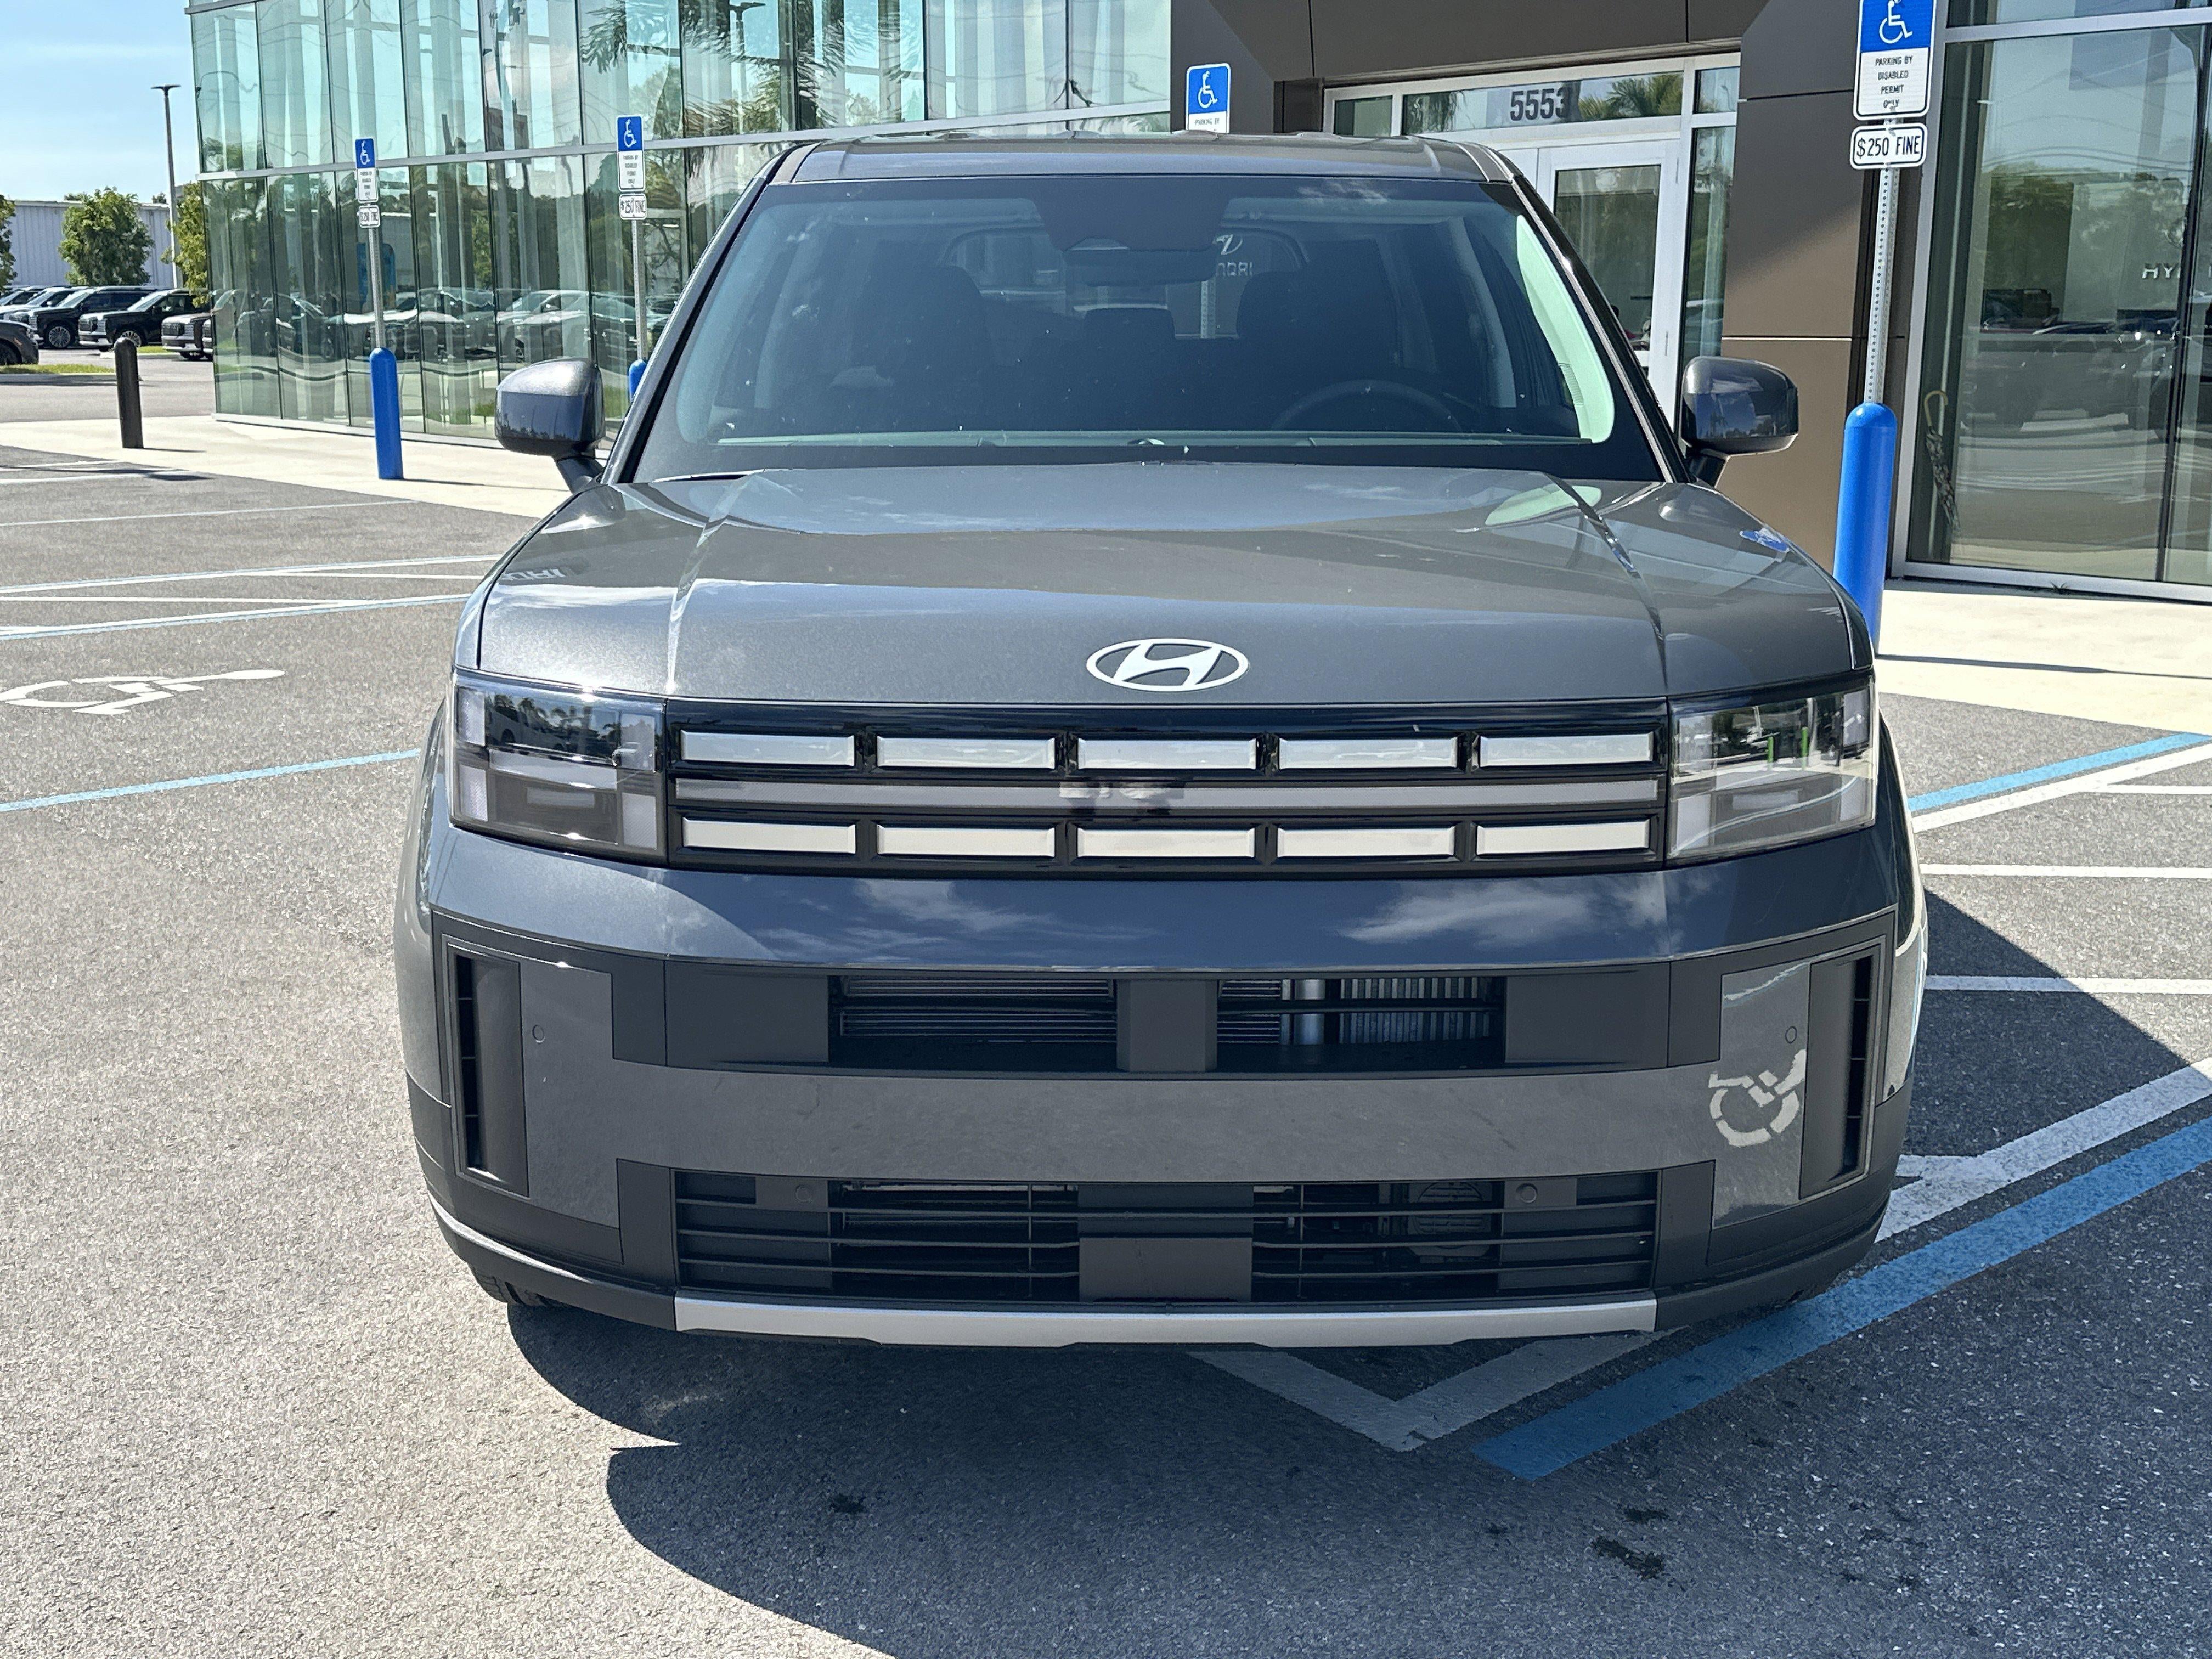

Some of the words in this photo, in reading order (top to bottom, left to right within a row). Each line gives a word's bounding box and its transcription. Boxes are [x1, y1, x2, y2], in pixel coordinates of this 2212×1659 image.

[1875, 57, 1902, 66] PARKING
[1904, 55, 1913, 64] BY
[1878, 70, 1909, 80] DISABLED
[1881, 84, 1904, 94] PERMIT
[1510, 88, 1569, 121] 5553
[1857, 138, 1889, 159] $250
[1895, 136, 1921, 154] FINE
